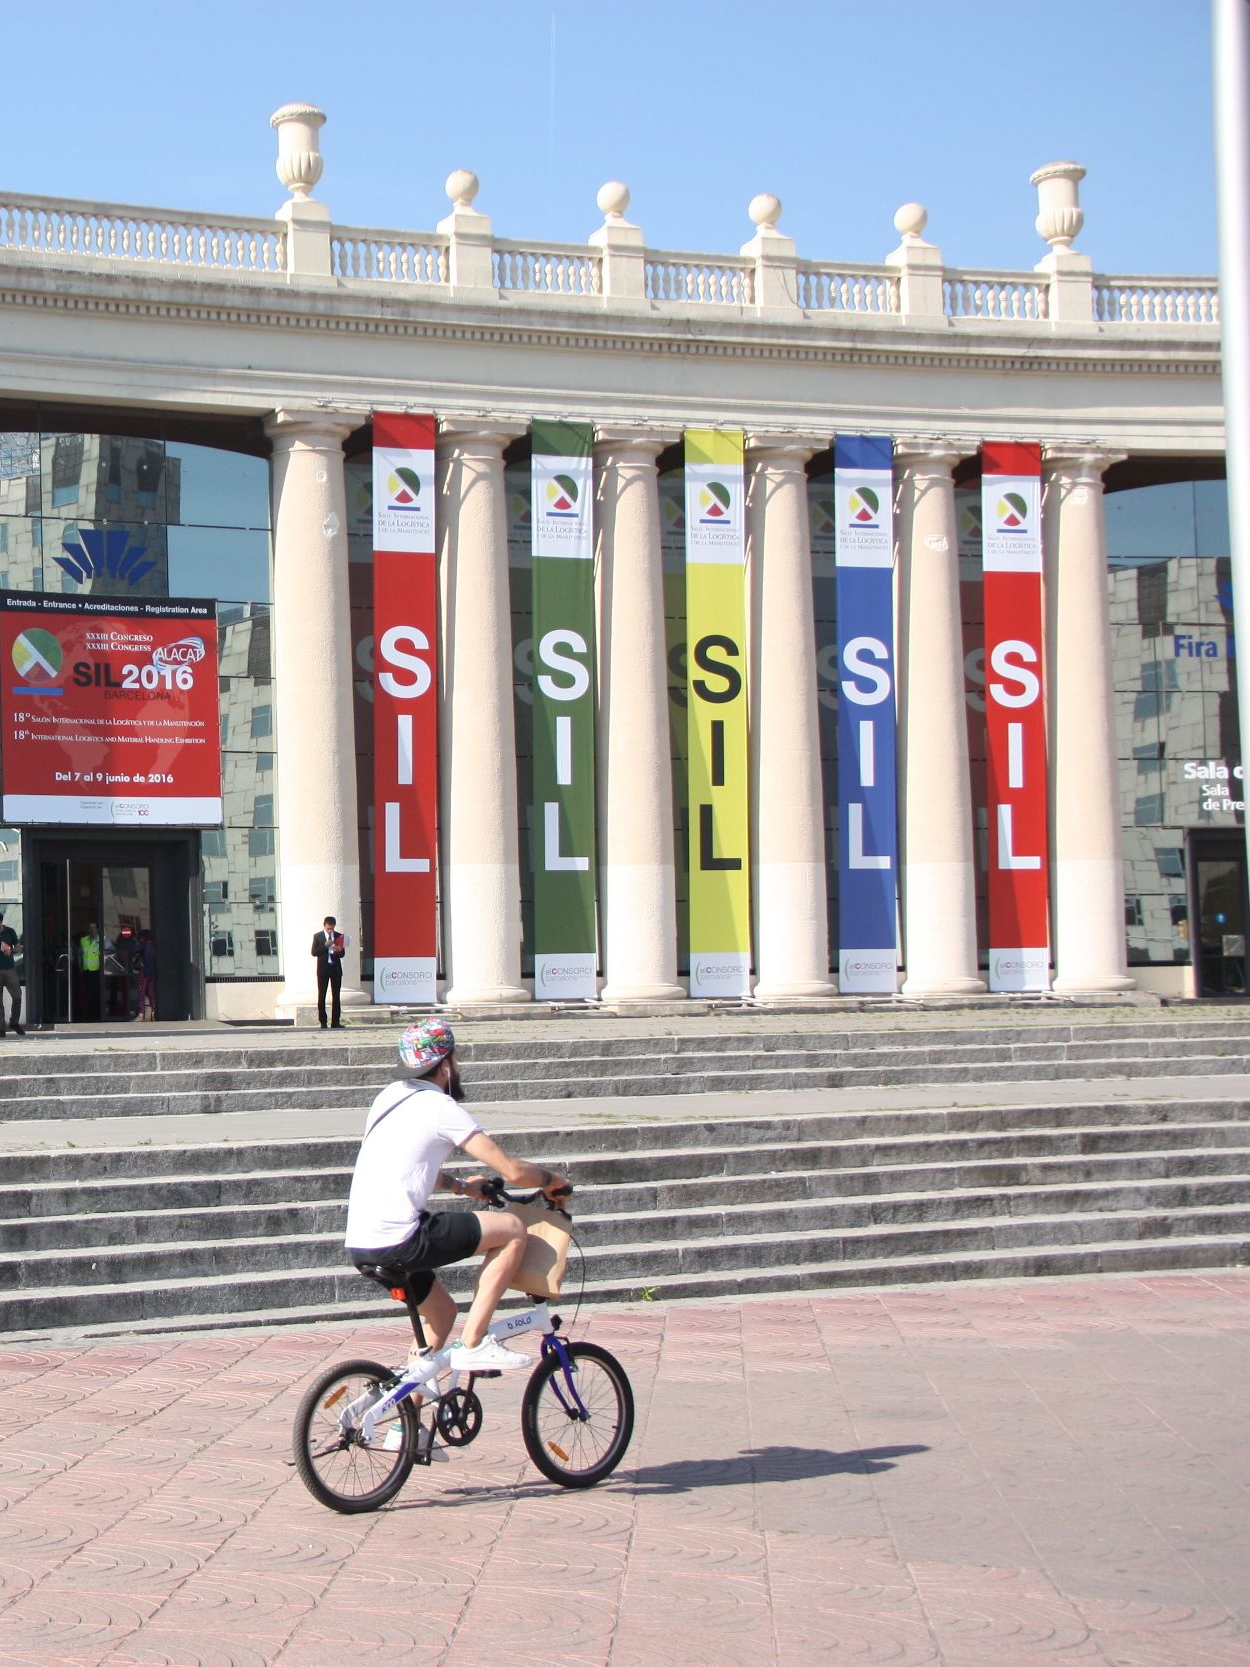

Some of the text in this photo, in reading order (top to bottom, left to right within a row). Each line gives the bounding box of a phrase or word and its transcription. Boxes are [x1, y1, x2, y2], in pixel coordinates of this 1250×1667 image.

[6, 599, 207, 614] Entrada Entrance Acreditaciones Registration Area
[110, 632, 153, 642] CONGRESO
[110, 642, 152, 652] CONGRESS
[1174, 635, 1218, 658] Fira
[155, 647, 203, 663] ALACAT
[104, 690, 171, 701] BARCELONA
[31, 715, 51, 723] SALÓN
[52, 716, 96, 725] INTERNACIONAL
[113, 718, 142, 726] LOGÍSTICA
[162, 719, 205, 727] MANUTENCIÓN
[31, 733, 74, 741] INTERNATIONAL
[75, 734, 104, 742] LOGISTICS
[117, 735, 144, 743] MATERIAL
[145, 736, 175, 744] HANDLING
[175, 736, 206, 744] EXHIBITION
[379, 626, 431, 872] SIL
[537, 629, 589, 871] SIL
[692, 635, 742, 870] SIL
[841, 637, 891, 869] SIL
[989, 640, 1041, 869] SIL
[1184, 762, 1229, 779] Sala
[55, 772, 174, 785] Del 7 al 9 junio de 2016
[1202, 784, 1229, 797] Sala
[1203, 798, 1244, 811] de Pre
